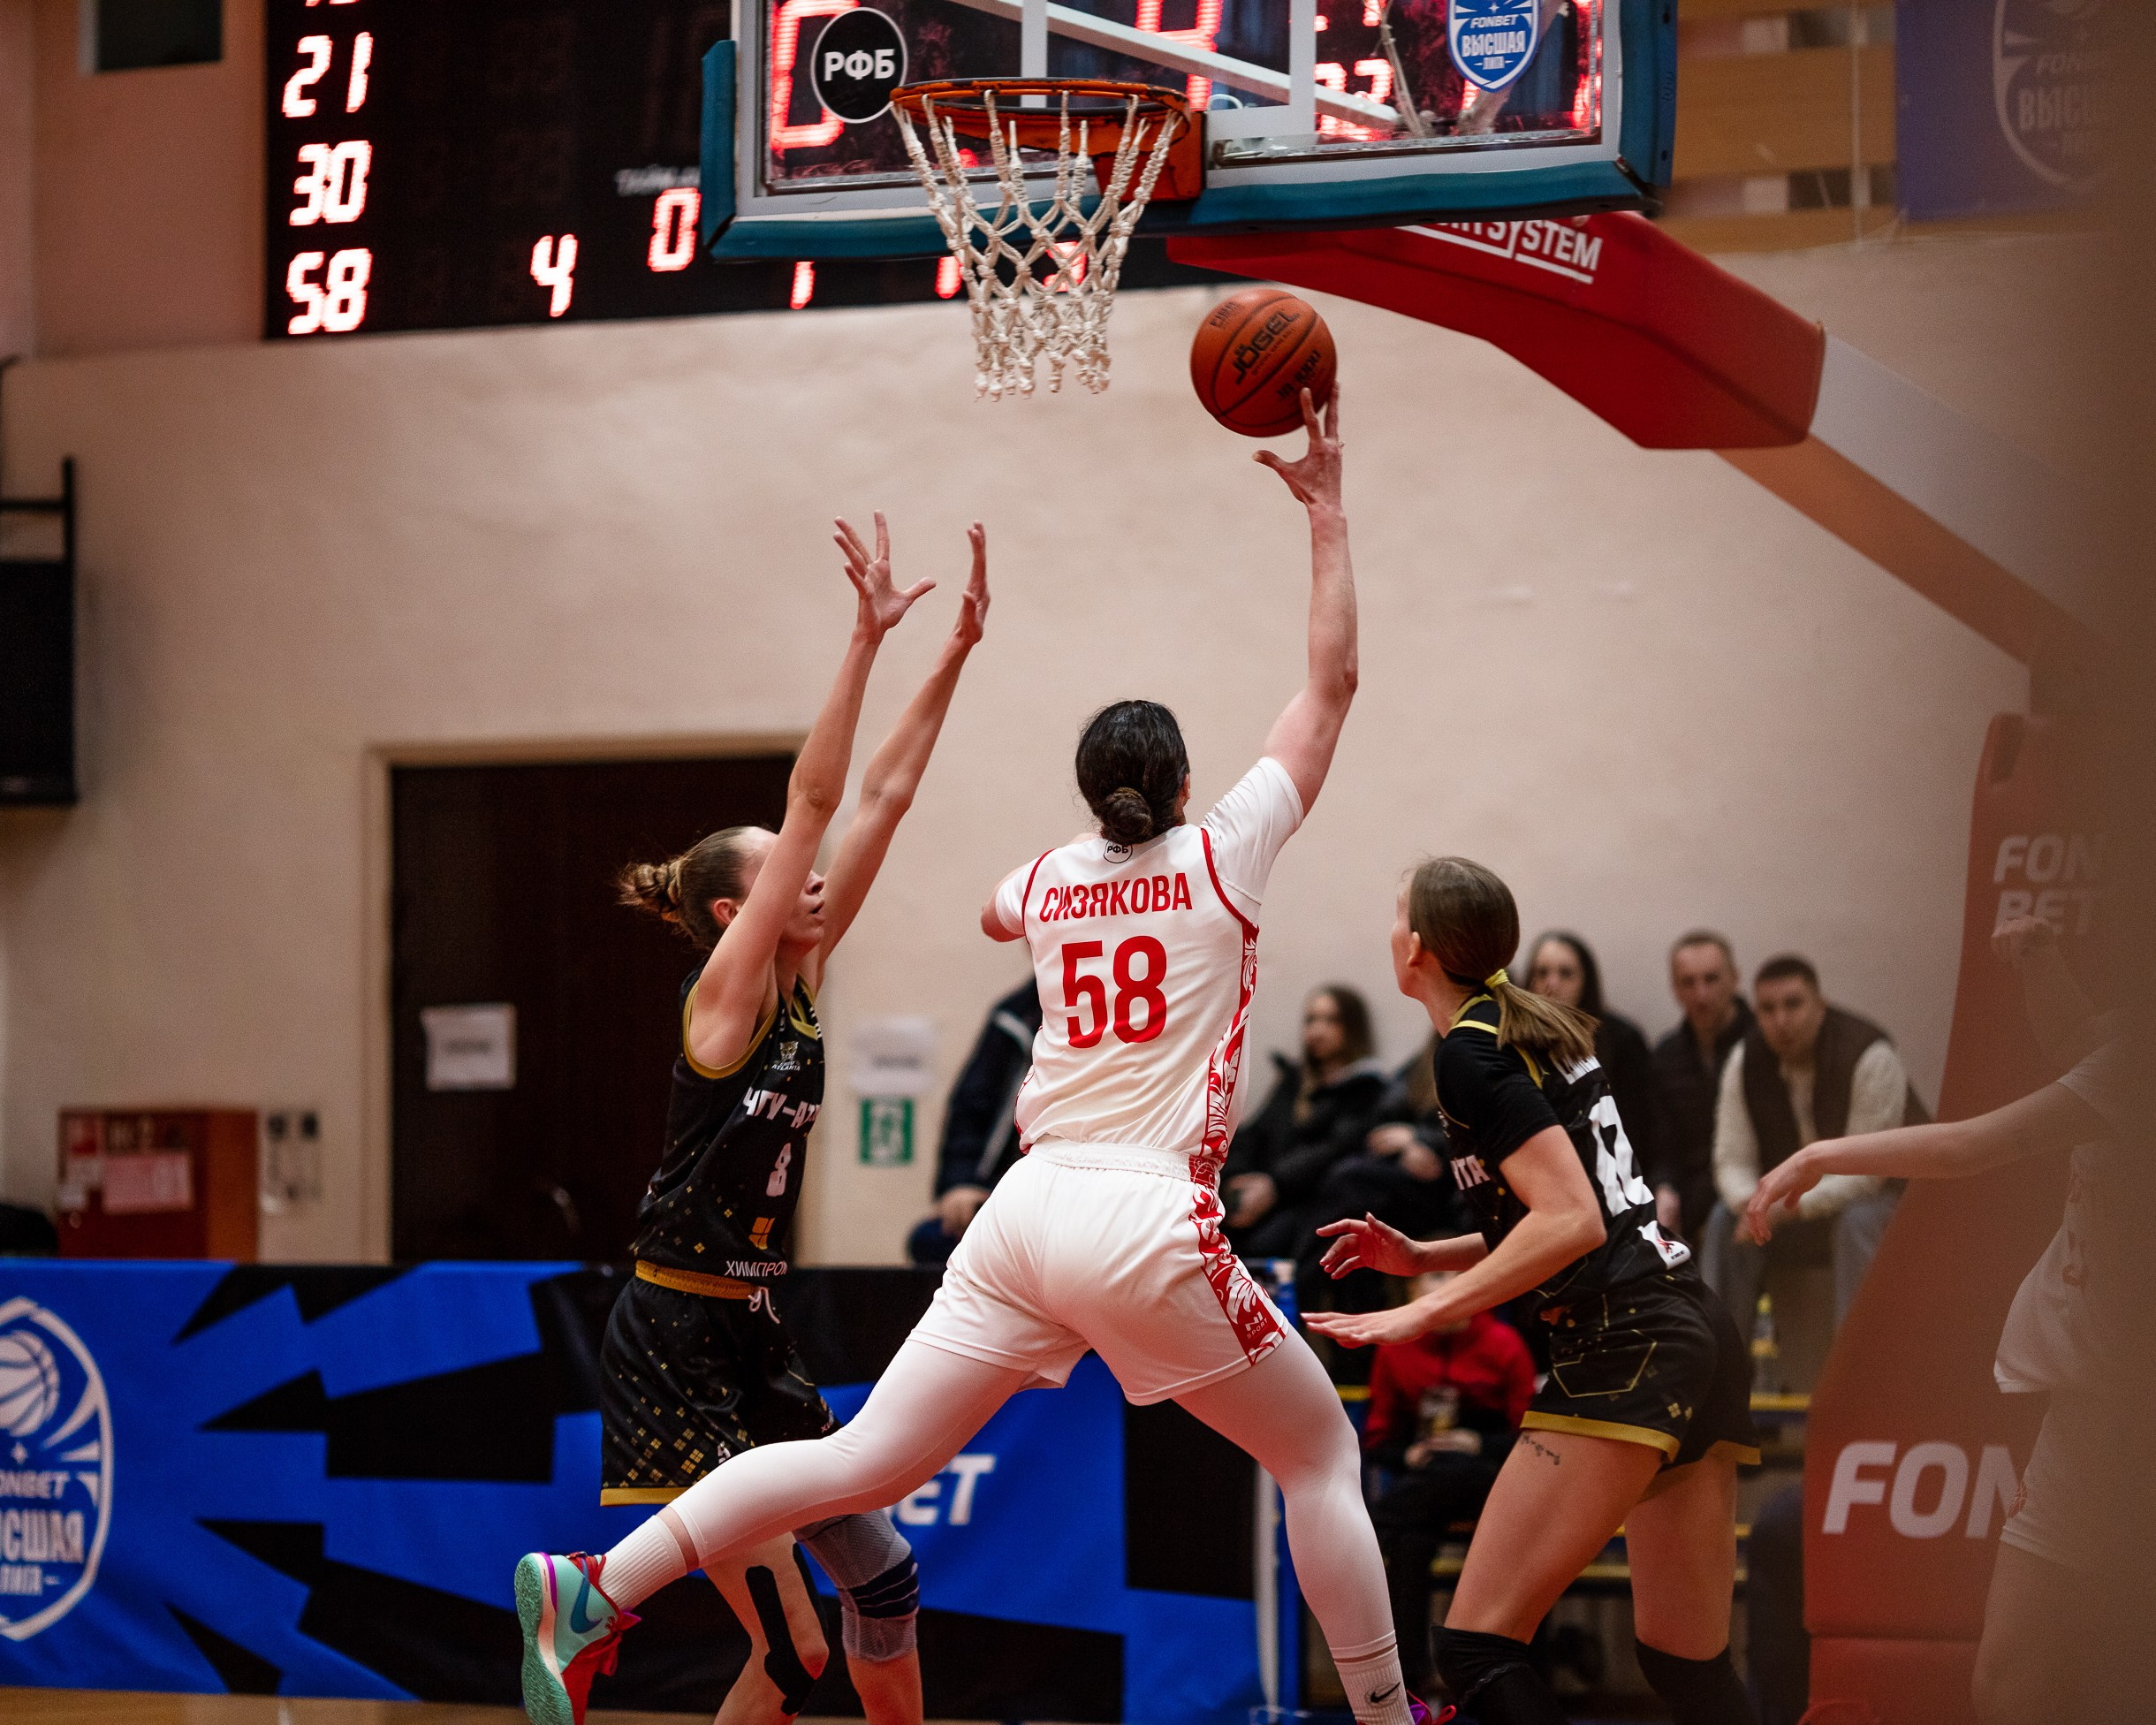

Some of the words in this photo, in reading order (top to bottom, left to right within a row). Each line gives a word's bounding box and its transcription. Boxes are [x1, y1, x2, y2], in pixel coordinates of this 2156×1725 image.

[1461, 30, 1526, 57] ВЫСШАЯ
[1469, 14, 1519, 28] FONBET
[281, 32, 373, 116] 21
[824, 49, 896, 81] РФБ
[289, 140, 372, 226] 30
[647, 187, 702, 272] 0
[285, 247, 373, 335] 58
[530, 234, 579, 317] 4
[1233, 309, 1301, 385] JÖGEL
[1106, 845, 1129, 855] РФБ
[1039, 872, 1193, 923] СИЗЯКОВА
[1061, 935, 1167, 1049] 58
[766, 1142, 792, 1197] 8
[1247, 1317, 1268, 1339] SPORT
[886, 1455, 996, 1525] ET
